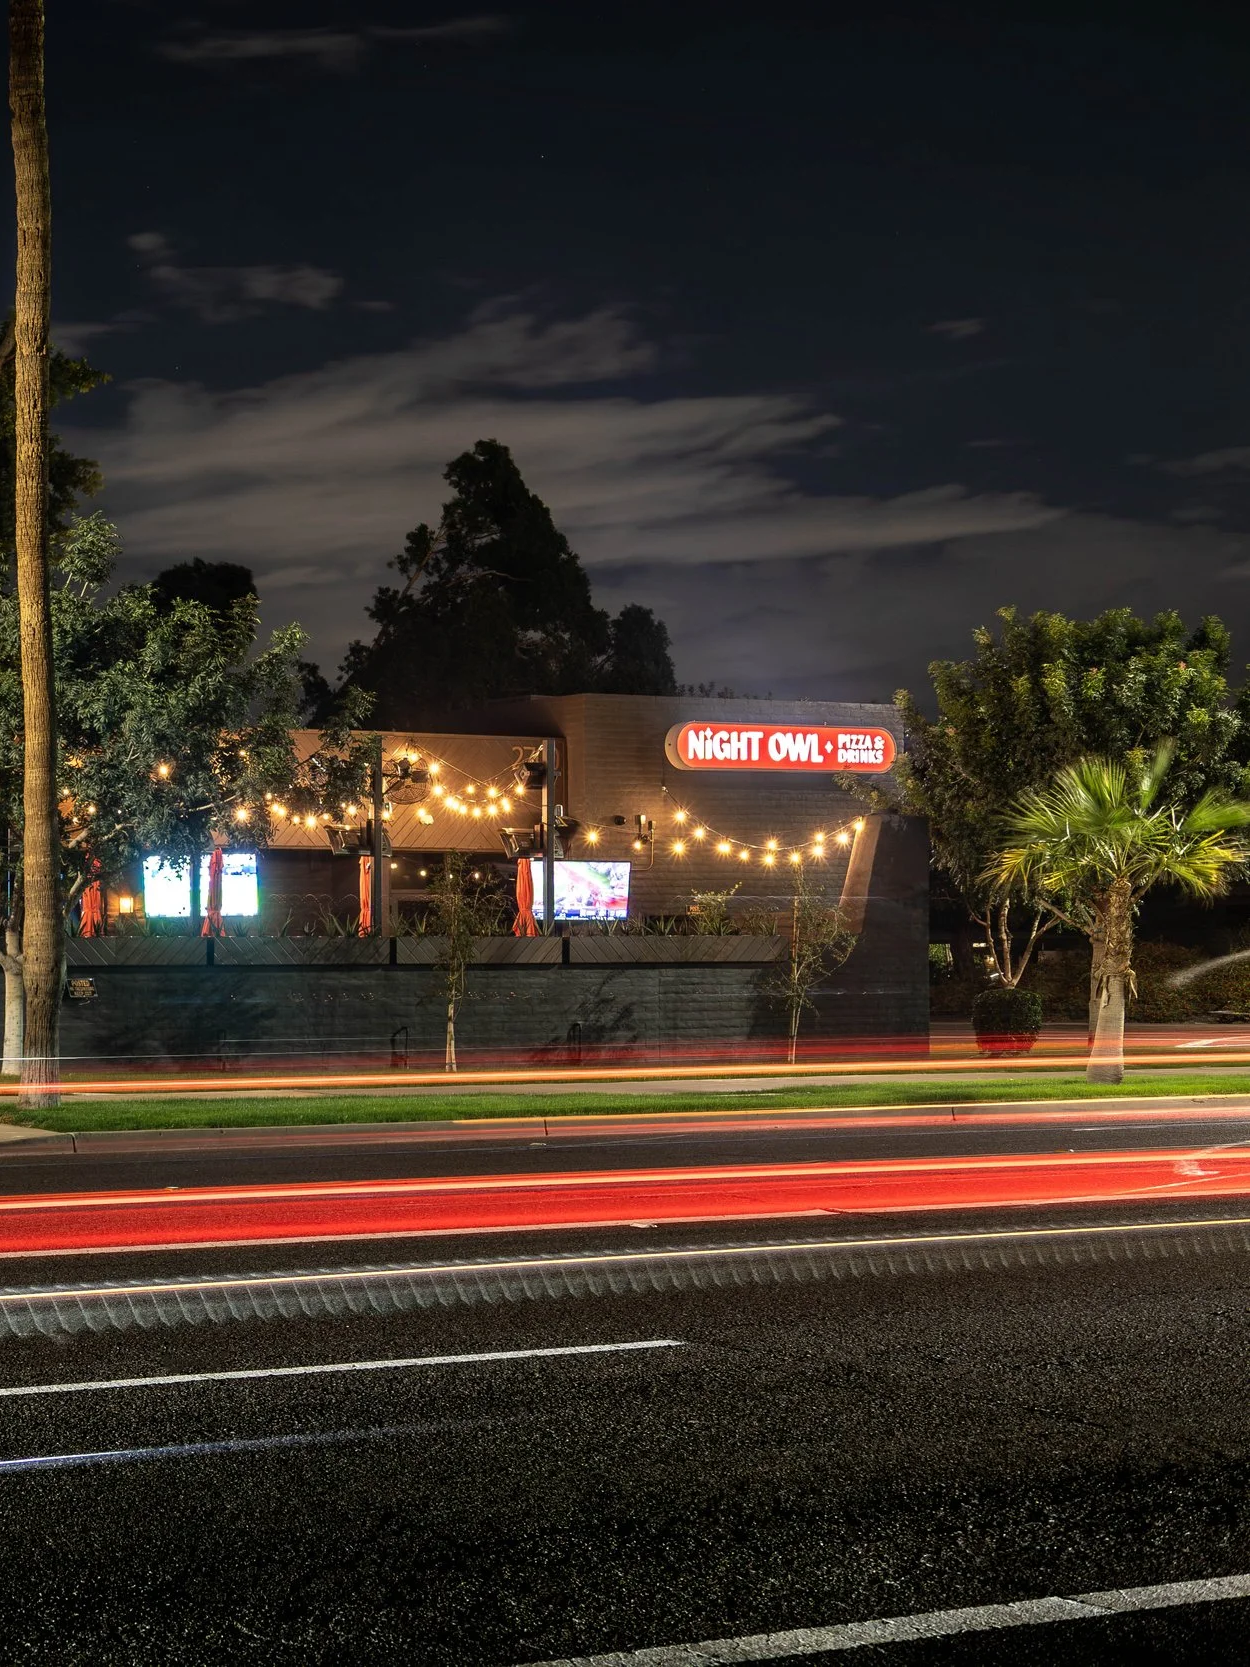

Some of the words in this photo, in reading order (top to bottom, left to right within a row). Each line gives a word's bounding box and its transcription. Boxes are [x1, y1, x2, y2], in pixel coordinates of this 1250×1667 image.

[768, 732, 823, 763] OWL
[837, 733, 872, 749] PIZZA
[874, 735, 885, 750] &
[837, 749, 884, 764] DRINKS
